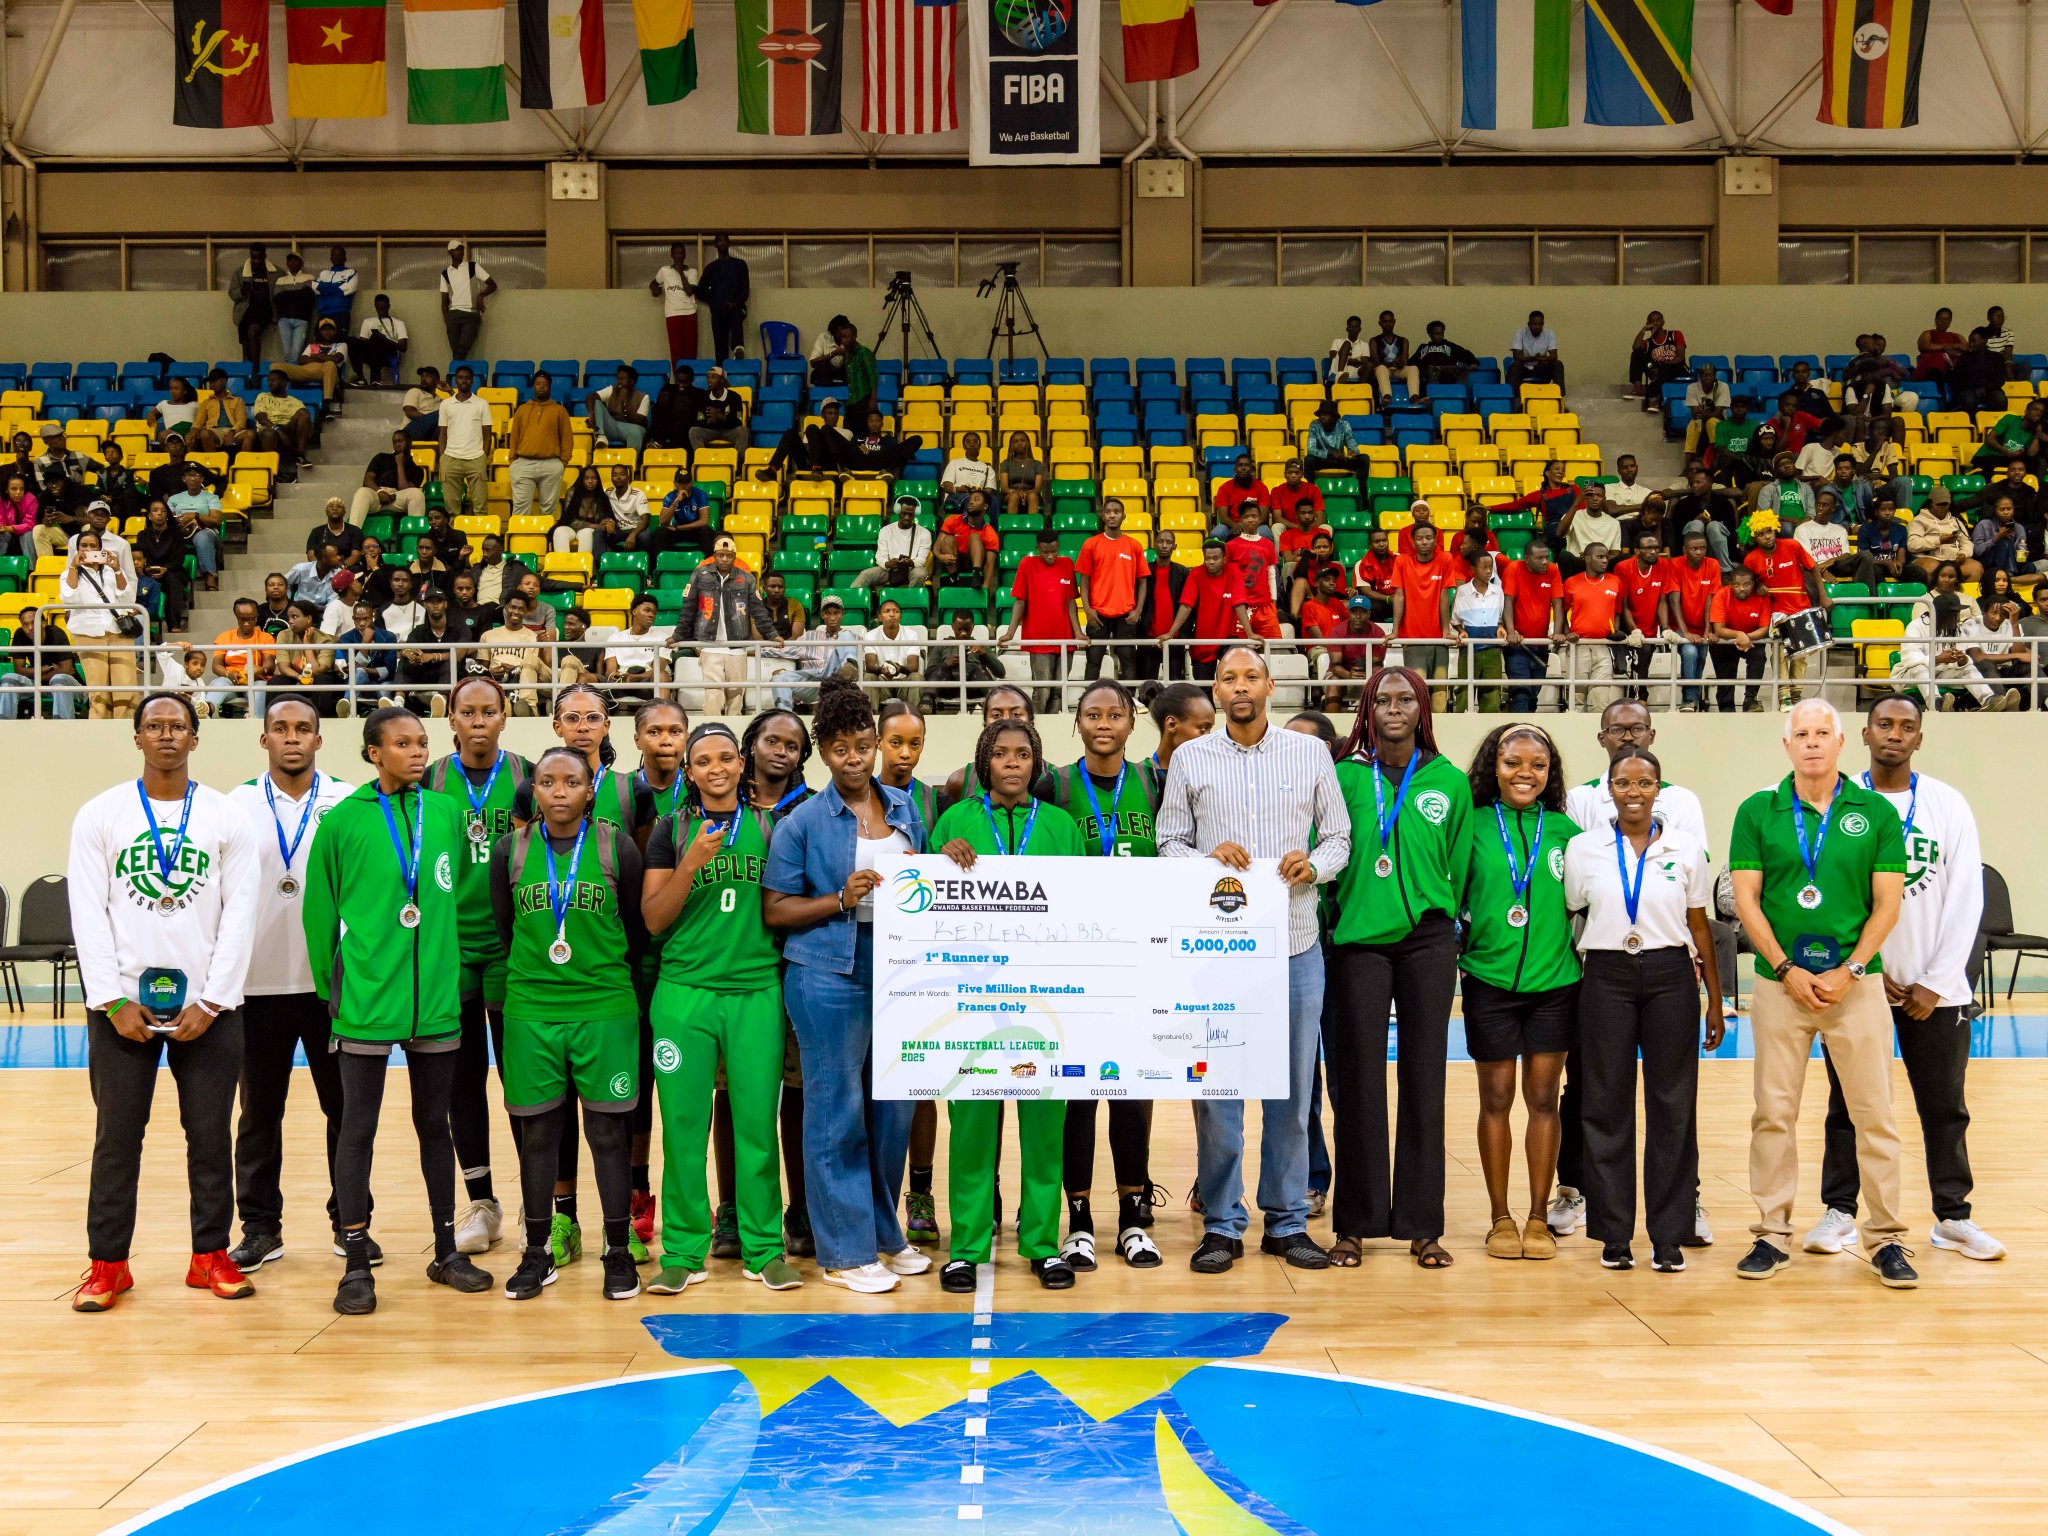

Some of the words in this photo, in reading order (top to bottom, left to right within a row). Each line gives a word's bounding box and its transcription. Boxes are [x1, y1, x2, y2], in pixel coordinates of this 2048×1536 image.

[1004, 73, 1064, 105] FIBA
[999, 132, 1012, 142] We
[1014, 132, 1029, 142] Are
[1030, 131, 1070, 141] Basketball
[469, 841, 490, 864] 15
[125, 880, 206, 912] BASKBALL
[933, 880, 1048, 901] FERWABA
[720, 888, 737, 913] 0
[1005, 904, 1046, 912] FEDERATION
[1181, 938, 1257, 954] 5,000,000
[925, 952, 939, 963] 1st
[941, 952, 990, 963] Runner
[992, 953, 1009, 966] up
[957, 983, 983, 994] Five
[985, 983, 1027, 994] Million
[1029, 984, 1085, 994] Rwandan
[957, 1002, 997, 1012] Francs
[999, 1002, 1027, 1014] Only
[1174, 1003, 1210, 1013] August
[1212, 1003, 1236, 1011] 2025
[901, 1041, 941, 1051] RWANDA
[944, 1041, 1006, 1051] BASKETBALL
[1009, 1041, 1046, 1051] LEAGUE
[1049, 1041, 1060, 1051] D1
[901, 1053, 926, 1062] 2025
[958, 1066, 998, 1076] betPawa
[1144, 1069, 1161, 1077] RBA
[971, 1088, 1041, 1096] 123456789000000
